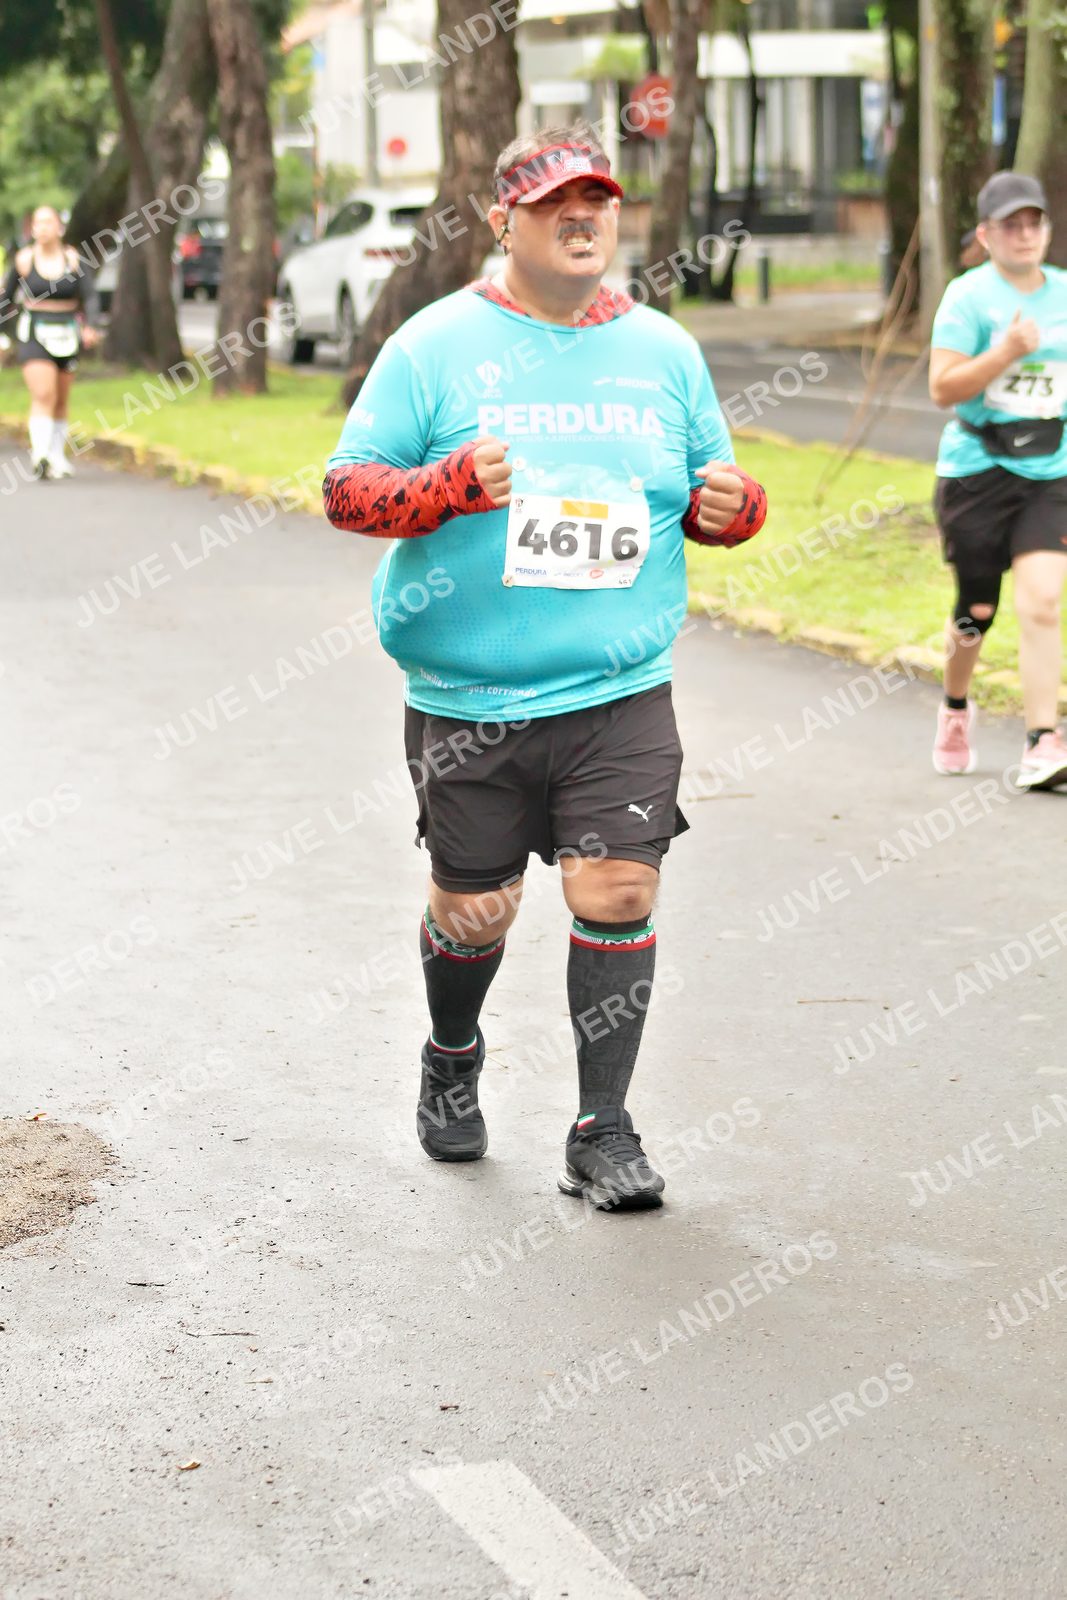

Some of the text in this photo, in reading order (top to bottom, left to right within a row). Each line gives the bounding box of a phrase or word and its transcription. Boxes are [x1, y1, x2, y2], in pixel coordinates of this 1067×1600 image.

[478, 403, 665, 438] PERDURA
[517, 518, 639, 562] 4616
[515, 567, 547, 576] PERDURA
